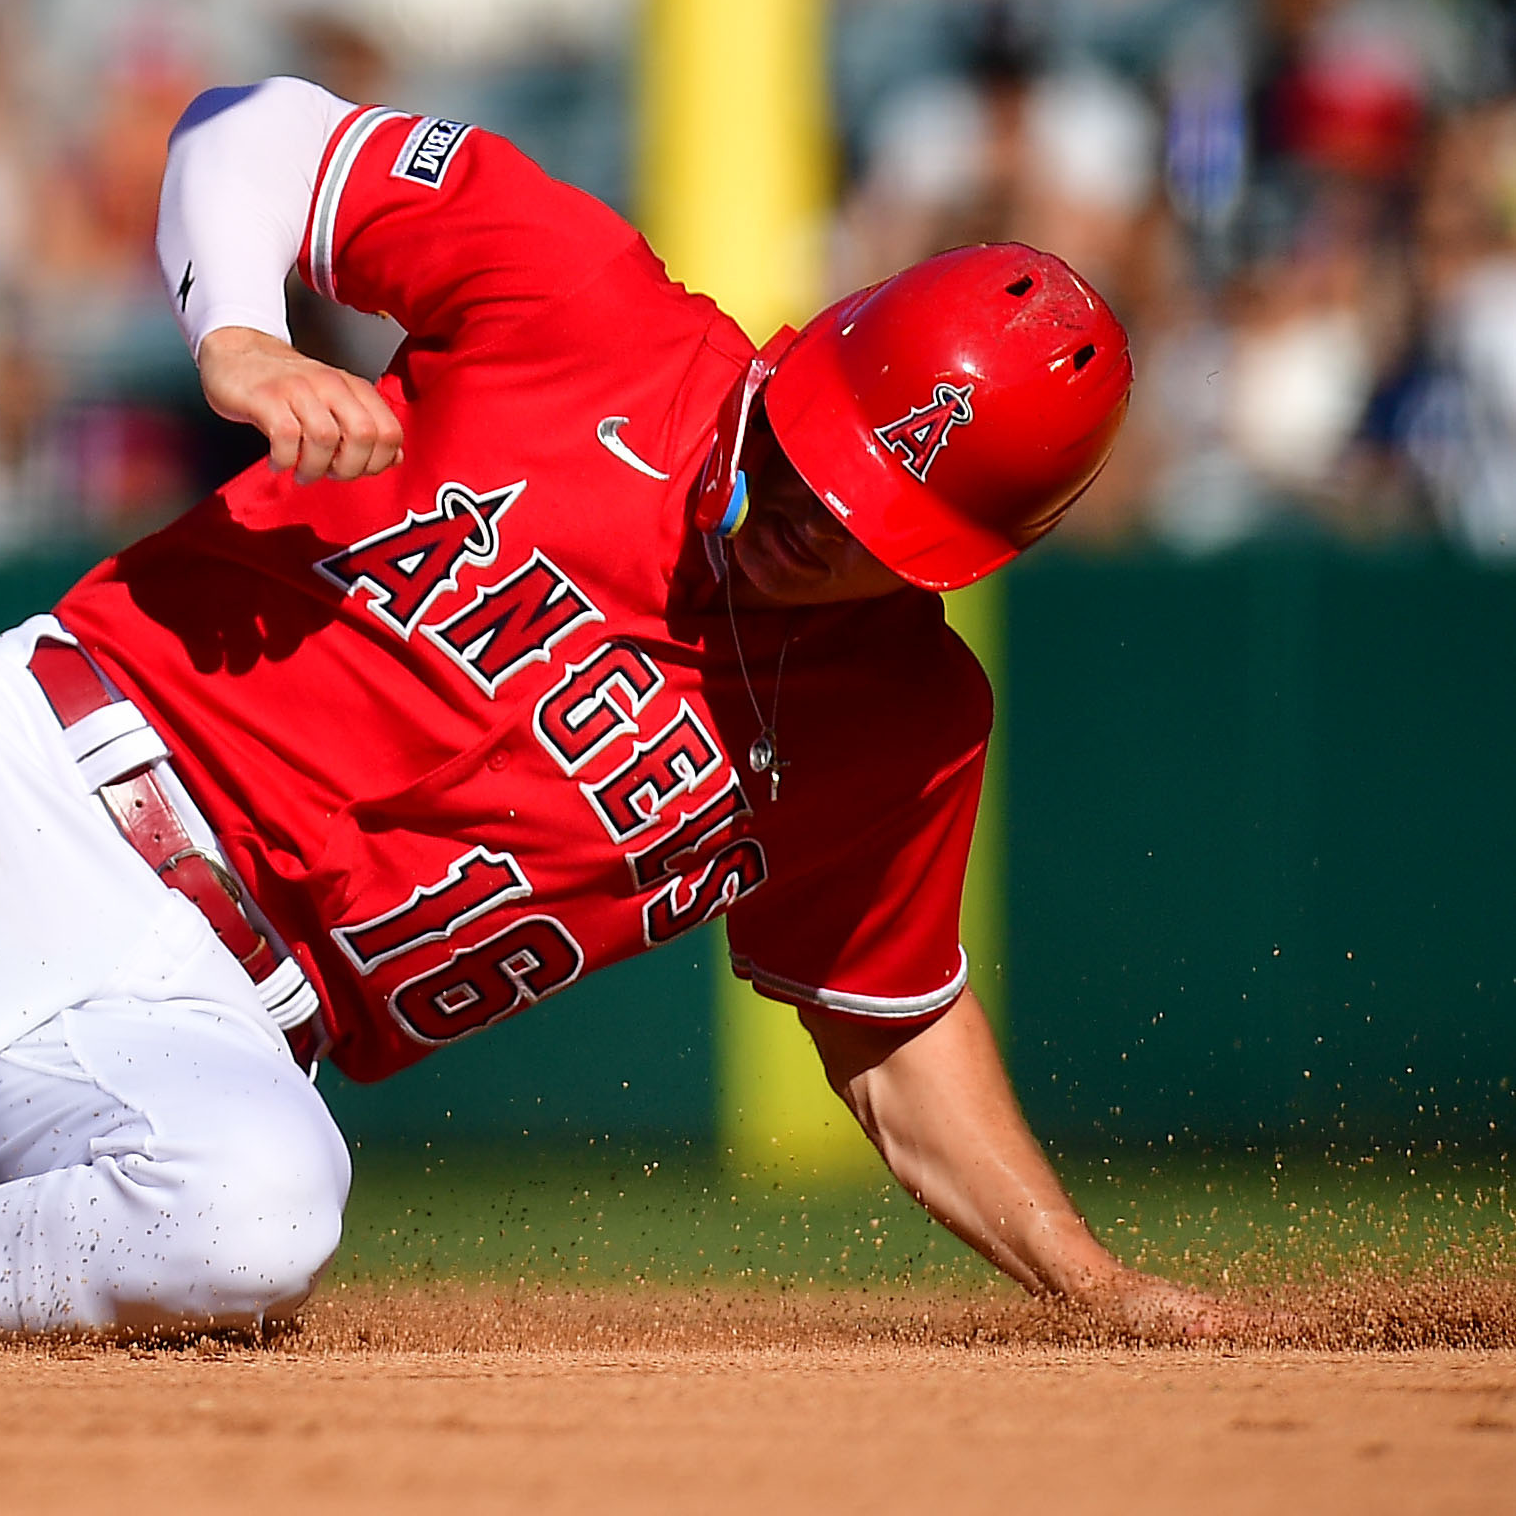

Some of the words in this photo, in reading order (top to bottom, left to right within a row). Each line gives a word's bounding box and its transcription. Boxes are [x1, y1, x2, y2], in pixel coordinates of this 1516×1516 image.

[874, 382, 974, 483] A
[314, 480, 767, 948] ANGELS
[331, 845, 584, 1044] 16
